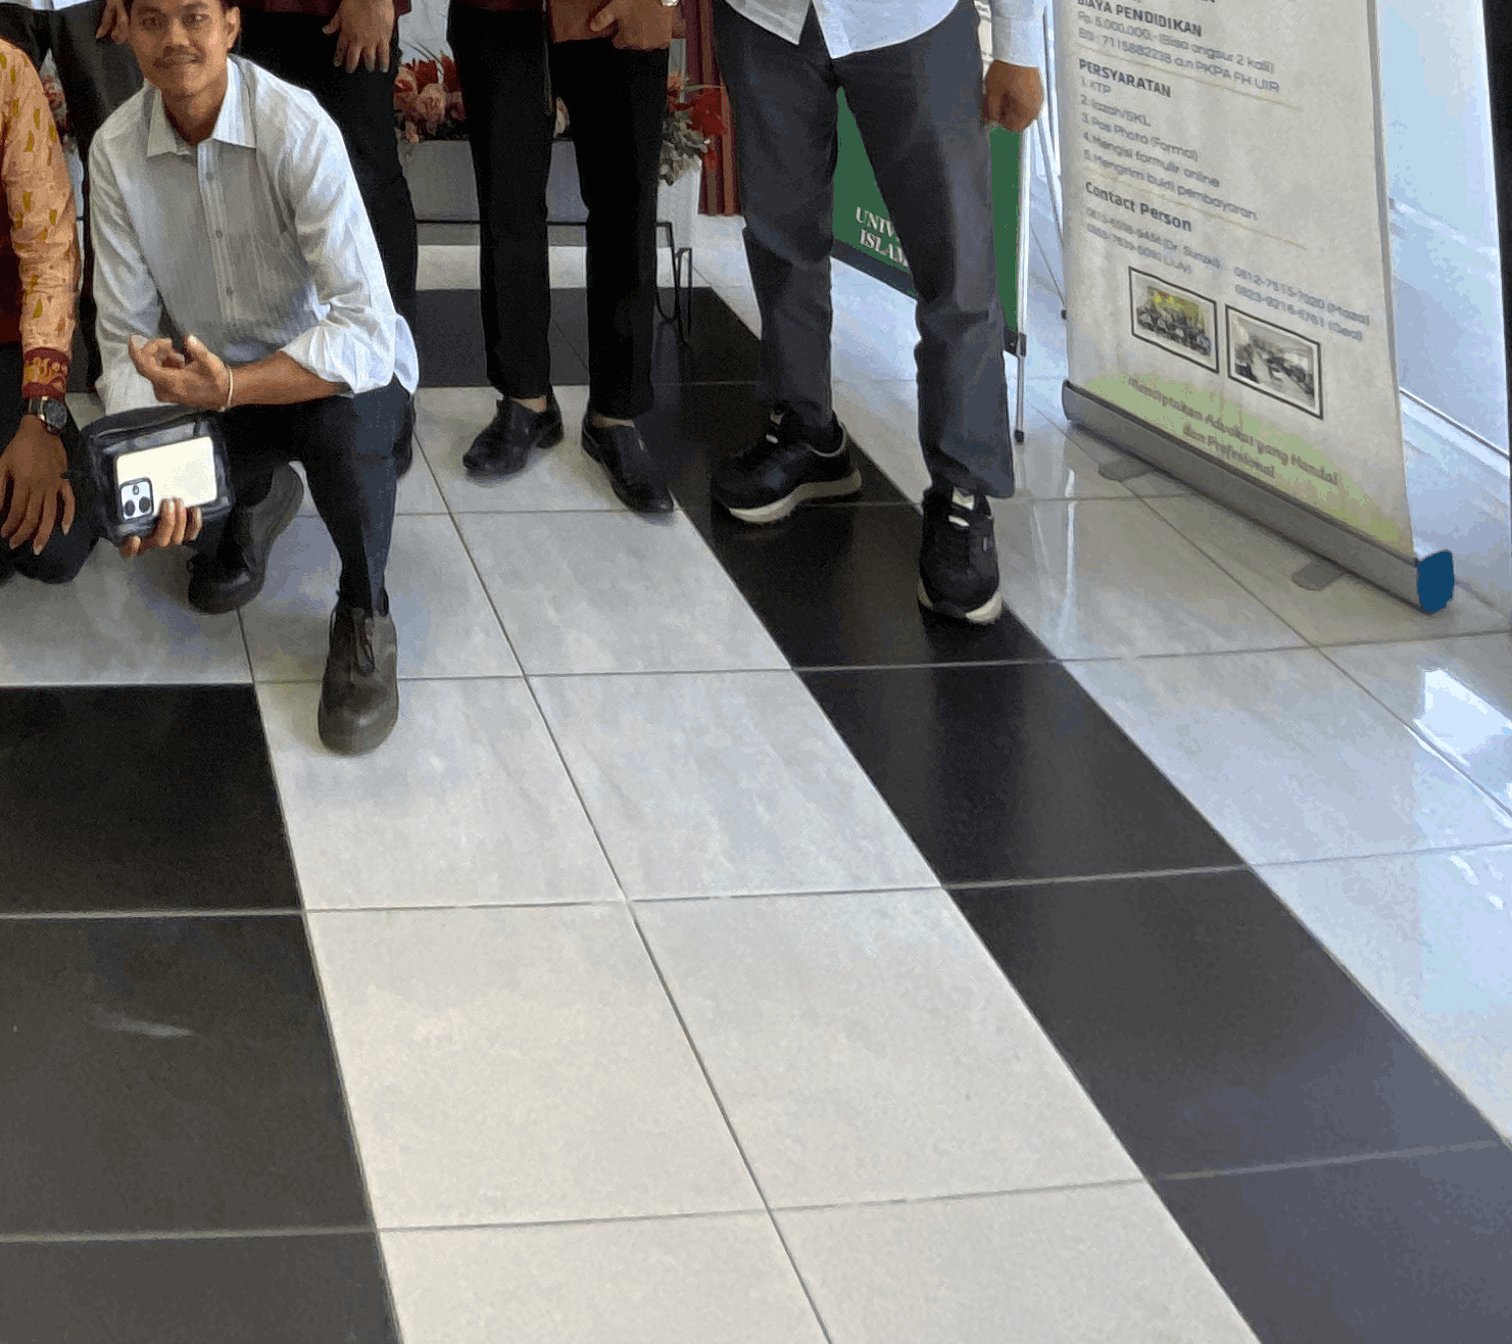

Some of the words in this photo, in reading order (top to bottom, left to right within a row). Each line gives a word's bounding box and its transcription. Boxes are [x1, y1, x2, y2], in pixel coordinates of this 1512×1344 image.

[1115, 3, 1202, 37] PENDIDIKAN
[1078, 57, 1172, 99] PERSYARATAN
[856, 206, 898, 240] UNIV
[1085, 181, 1135, 213] Contact
[1139, 202, 1193, 232] Person
